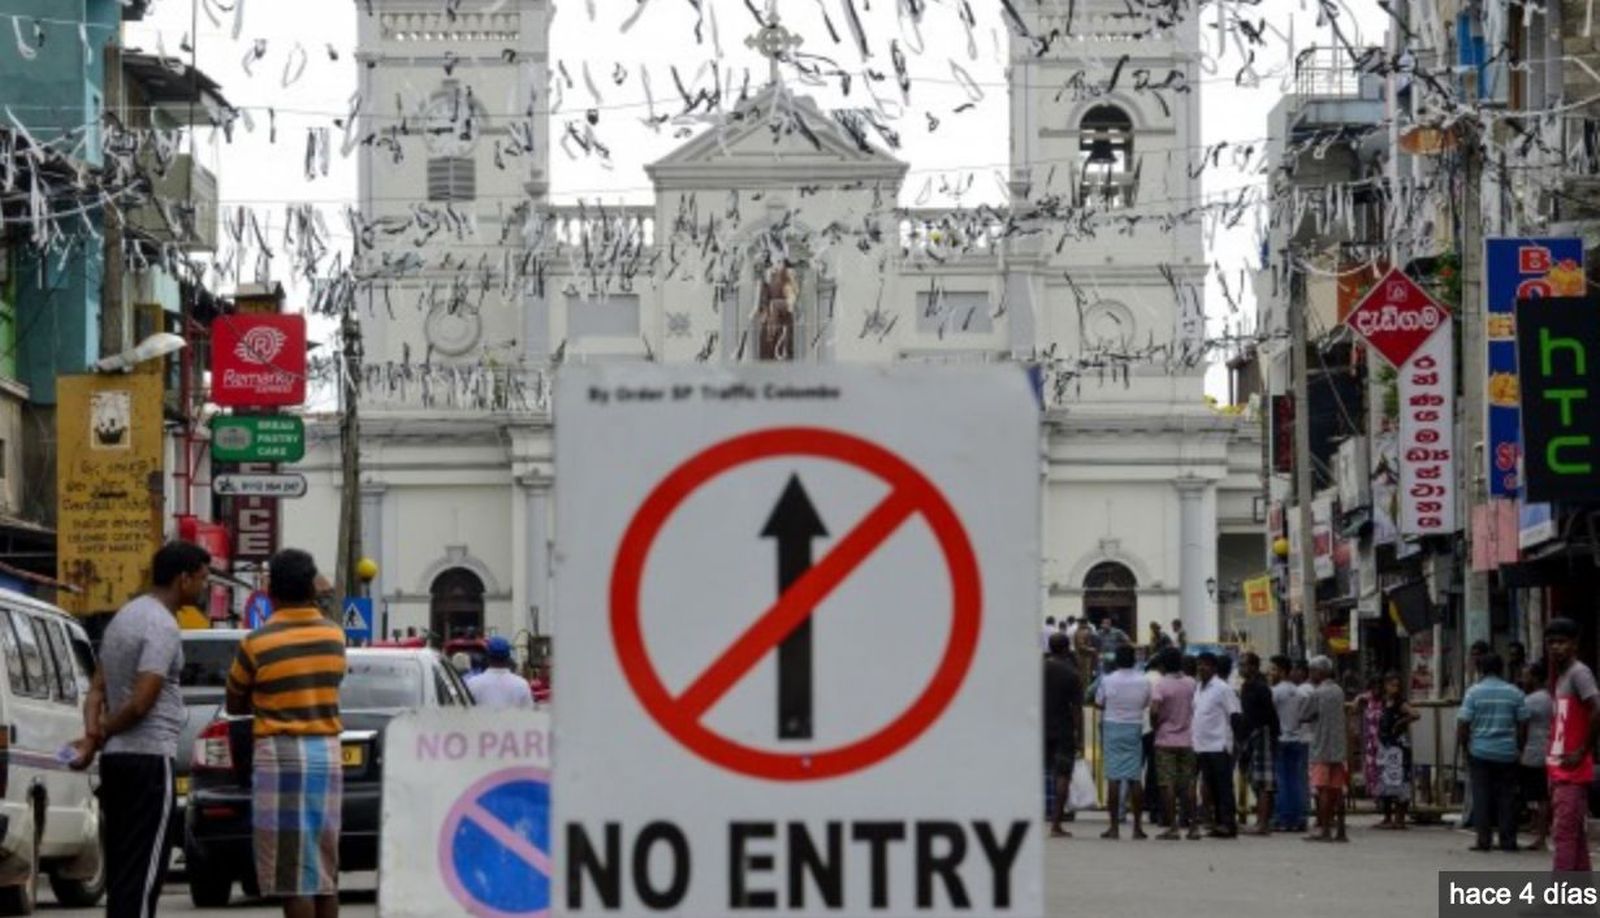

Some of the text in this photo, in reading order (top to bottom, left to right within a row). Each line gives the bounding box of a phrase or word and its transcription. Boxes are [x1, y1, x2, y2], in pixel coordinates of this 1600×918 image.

[616, 385, 664, 400] Order
[701, 383, 756, 400] Traffic
[763, 383, 841, 400] Colombo
[257, 434, 298, 443] PASTRY
[417, 730, 550, 762] NO PAR
[565, 821, 1031, 911] NO ENTRY
